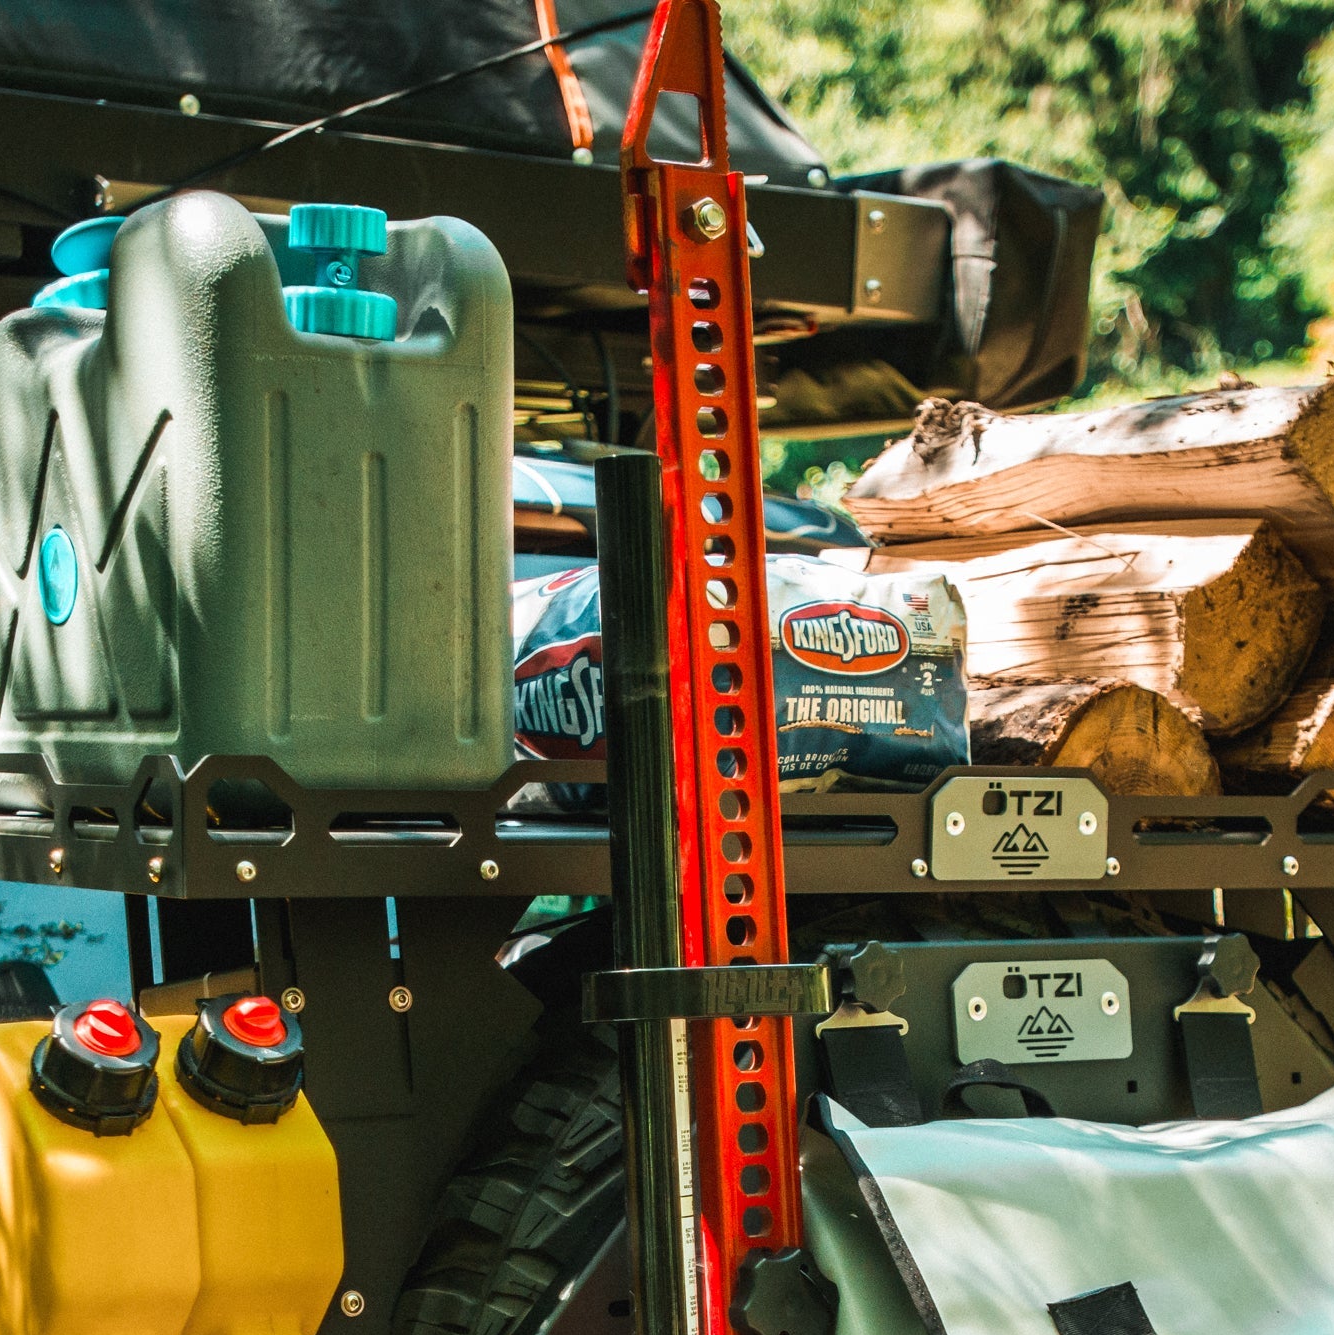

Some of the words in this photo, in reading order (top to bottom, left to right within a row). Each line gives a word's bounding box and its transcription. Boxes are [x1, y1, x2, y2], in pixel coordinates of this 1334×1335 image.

[792, 610, 901, 662] KINGSFORD
[915, 621, 933, 632] USA
[801, 685, 823, 694] 100%
[825, 686, 854, 695] NATURAL
[855, 686, 895, 697] INGREDIENTS
[923, 671, 933, 686] 2
[514, 656, 603, 746] KINGSF
[785, 697, 820, 721] THE
[826, 698, 906, 724] ORIGINAL
[777, 754, 800, 764] COAL
[982, 782, 1063, 816] ÖTZI
[1002, 966, 1083, 999] ÖTZI
